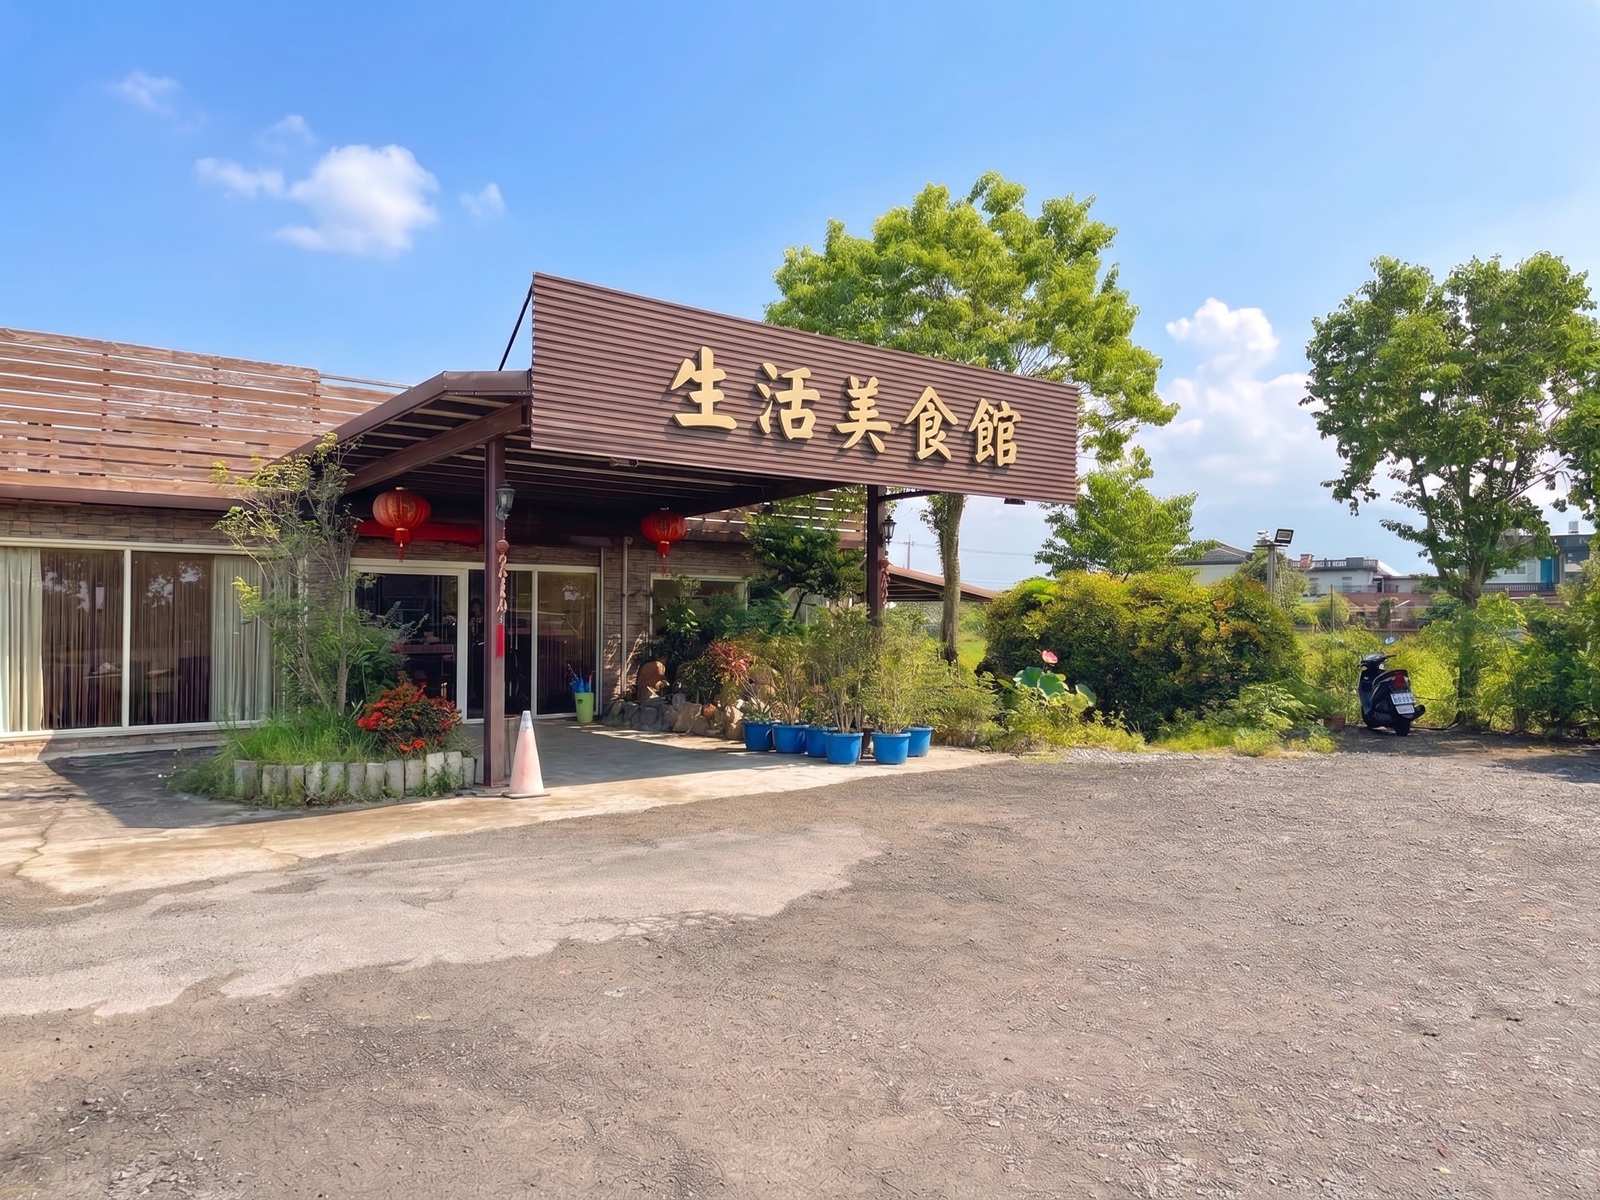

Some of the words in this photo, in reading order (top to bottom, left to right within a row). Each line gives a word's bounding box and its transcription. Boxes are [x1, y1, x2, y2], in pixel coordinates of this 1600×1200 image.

[670, 346, 1021, 466] 生活美食館
